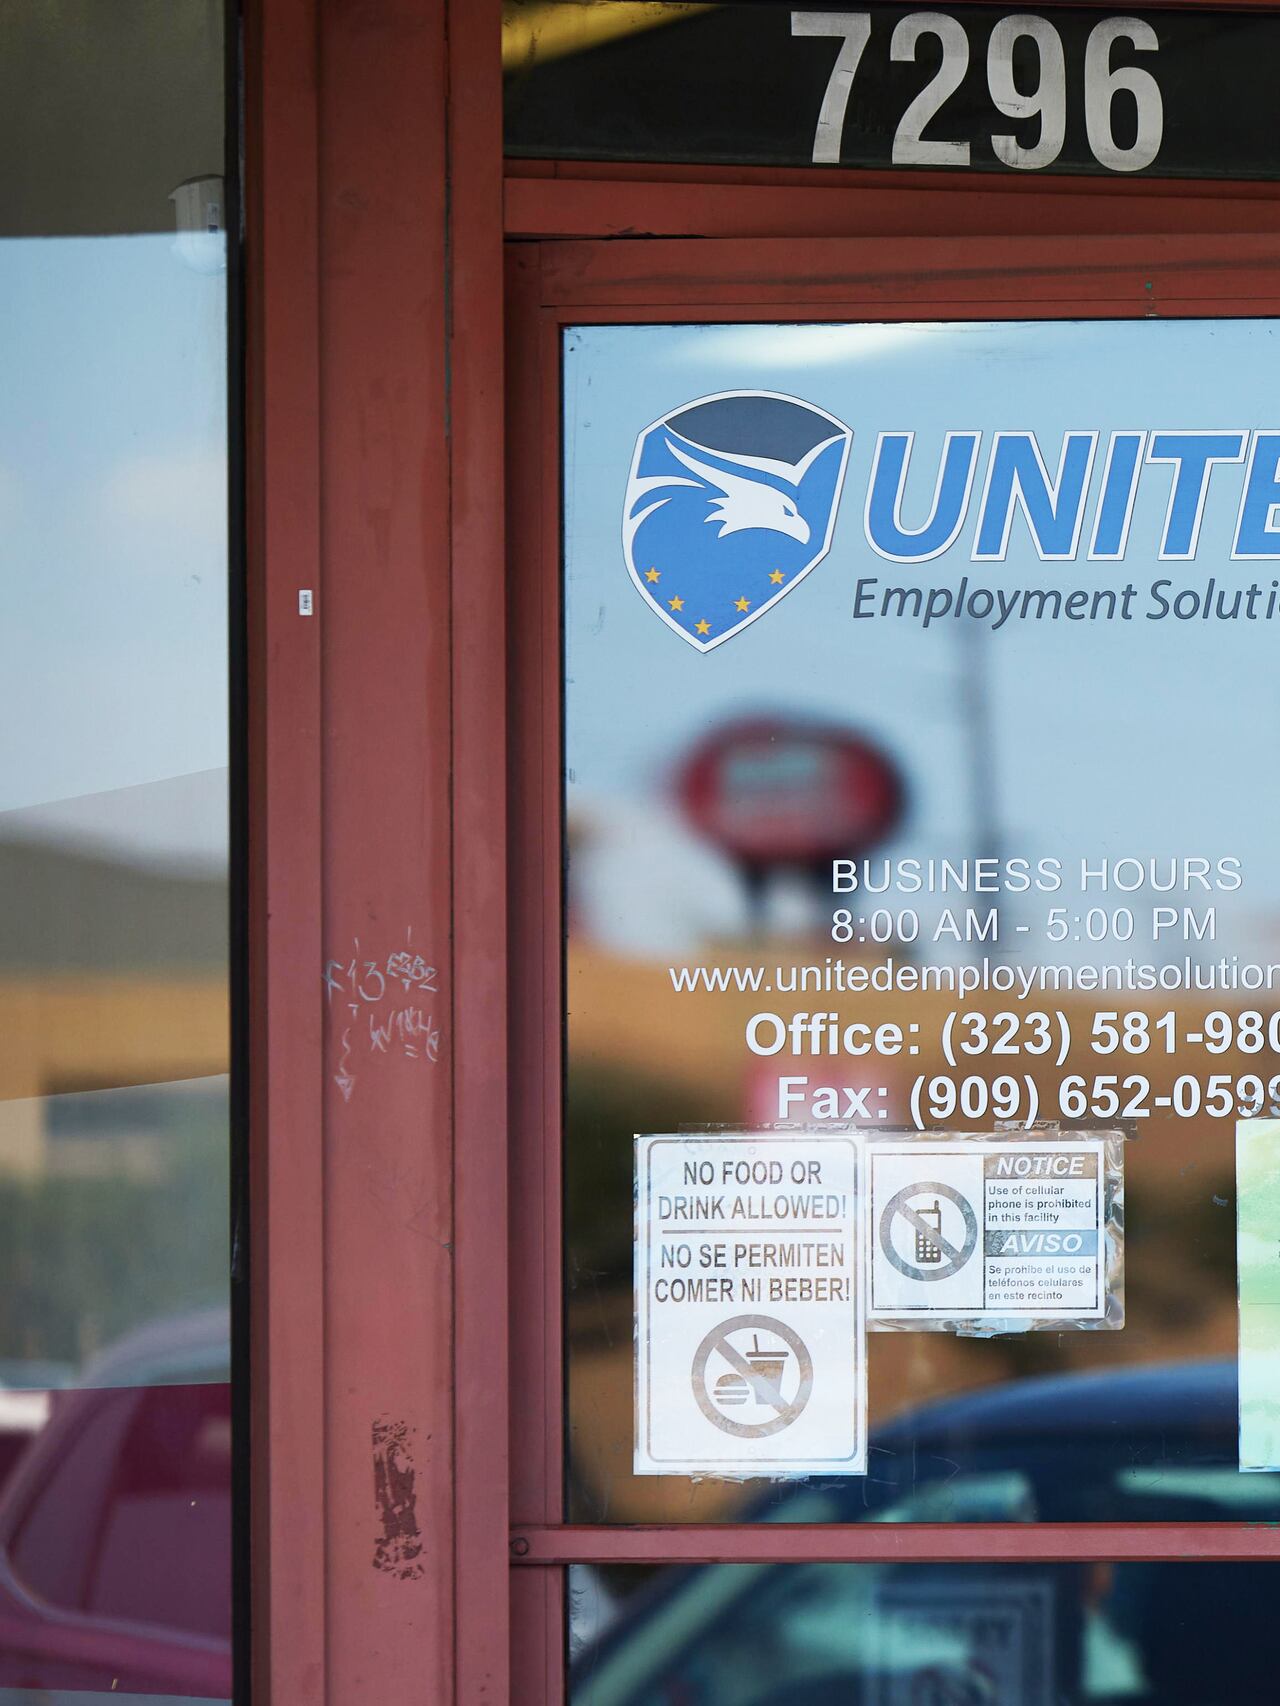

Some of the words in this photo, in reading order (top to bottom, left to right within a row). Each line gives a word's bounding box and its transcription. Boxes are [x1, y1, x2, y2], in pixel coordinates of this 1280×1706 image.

[791, 11, 1163, 171] 7296
[853, 577, 1137, 630] Employment
[832, 857, 1063, 893] BUSINESS
[1080, 856, 1243, 892] HOURS
[831, 908, 919, 943] 8:00
[932, 908, 999, 943] AM
[1046, 906, 1135, 943] 5:00
[1152, 906, 1217, 942] PM
[745, 1012, 920, 1056] Office:
[942, 1010, 1071, 1067] (323)
[778, 1075, 889, 1120] Fax:
[910, 1074, 1040, 1131] (909)
[684, 1161, 715, 1185] NO
[722, 1161, 783, 1185] FOOD
[790, 1160, 822, 1185] OR
[996, 1156, 1085, 1175] NOTICE
[988, 1186, 1009, 1195] Use
[1011, 1186, 1023, 1195] of
[1025, 1186, 1065, 1195] cellular
[658, 1195, 725, 1220] DRINK
[731, 1195, 847, 1219] ALLOWED!
[988, 1200, 1022, 1210] phone
[1024, 1199, 1034, 1208] is
[1037, 1199, 1091, 1210] prohibited
[988, 1213, 998, 1222] in
[1001, 1213, 1021, 1222] this
[1024, 1212, 1060, 1224] facility
[661, 1244, 692, 1268] NO
[699, 1244, 727, 1268] SE
[734, 1243, 845, 1268] PERMITEN
[999, 1233, 1083, 1253] AVISO
[988, 1265, 1002, 1274] Se
[1004, 1265, 1043, 1276] prohibe
[1045, 1265, 1054, 1274] el
[1057, 1266, 1076, 1274] uso
[1079, 1265, 1091, 1274] de
[988, 1277, 1035, 1287] teléfonos
[1037, 1278, 1084, 1287] celulares
[655, 1278, 734, 1303] COMER
[741, 1278, 761, 1302] NI
[769, 1277, 850, 1302] BEBER!
[1003, 1292, 1025, 1300] este
[1027, 1291, 1063, 1300] recinto
